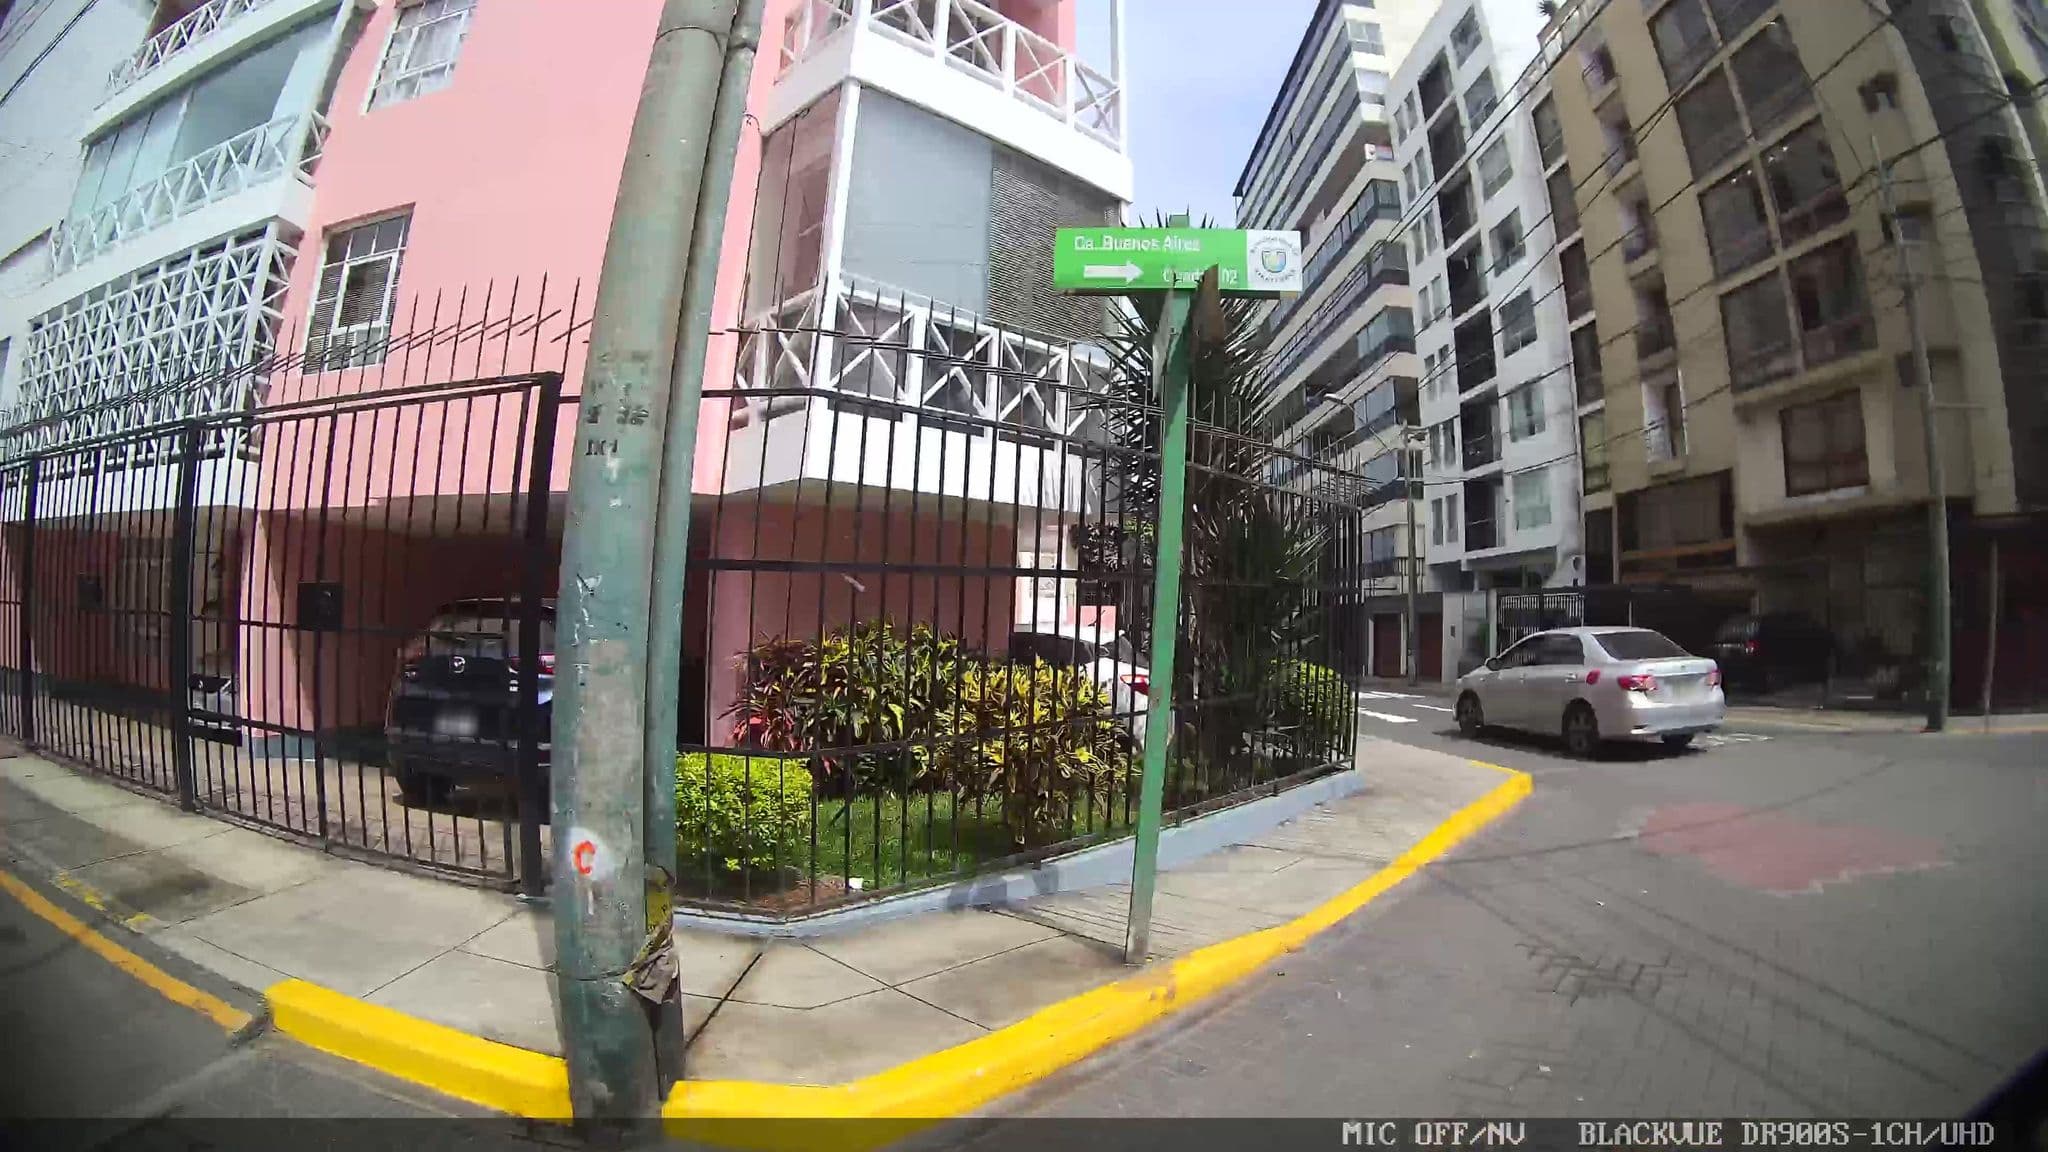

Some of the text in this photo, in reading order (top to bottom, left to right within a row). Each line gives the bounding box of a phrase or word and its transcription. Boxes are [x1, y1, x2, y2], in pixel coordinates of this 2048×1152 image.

[1102, 236, 1158, 251] Buenos
[1163, 235, 1201, 251] Aires
[1221, 268, 1238, 284] 02
